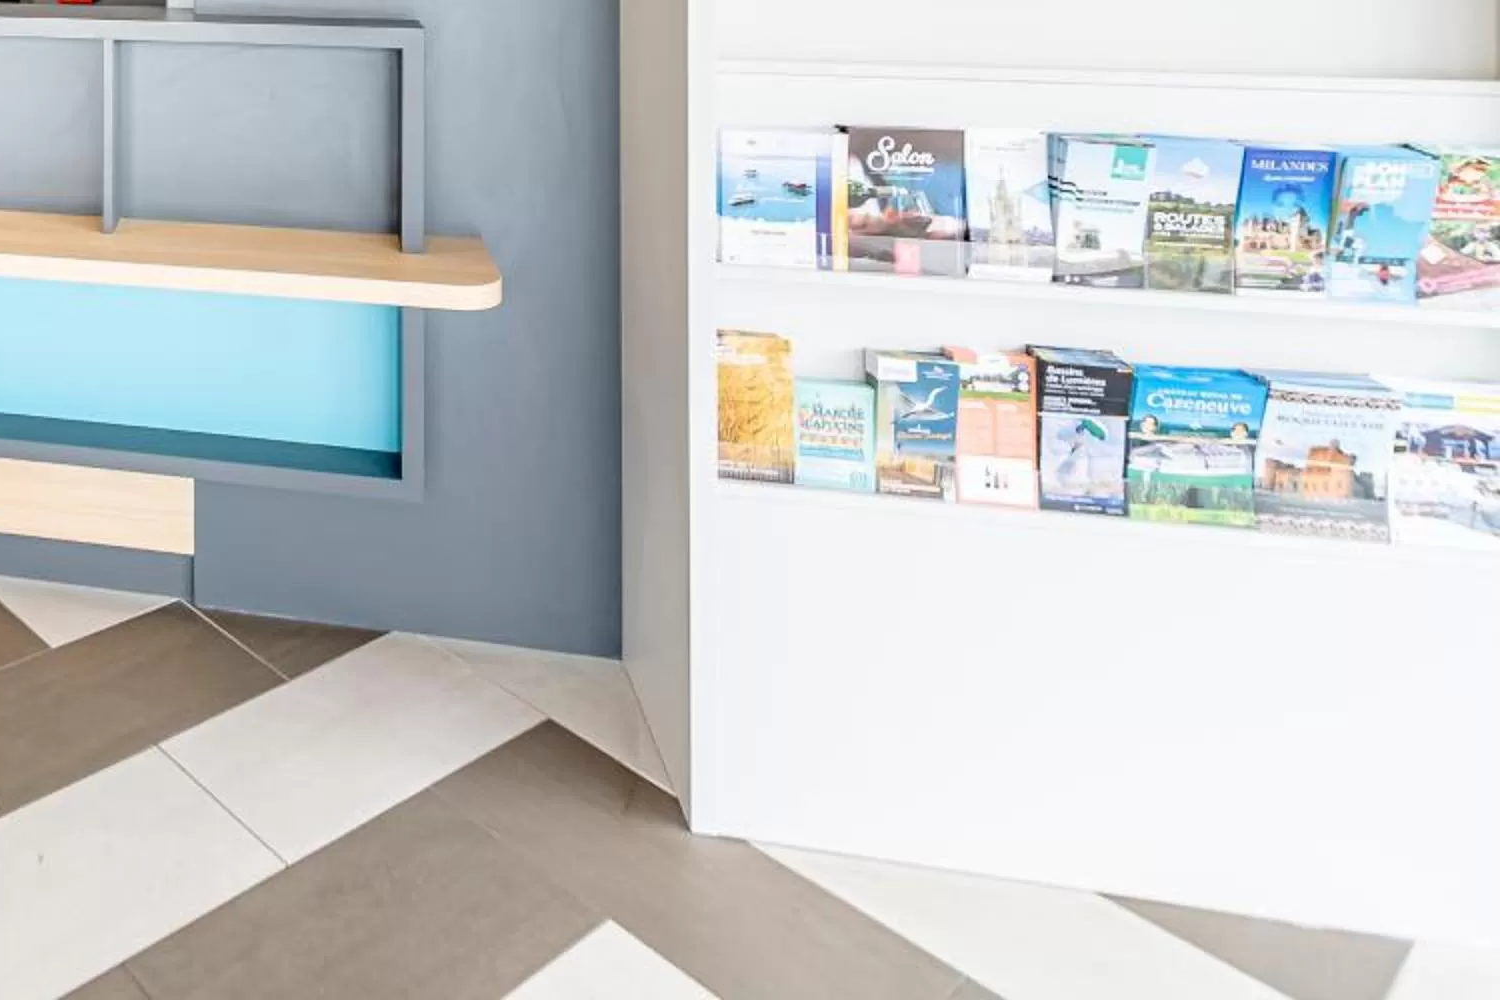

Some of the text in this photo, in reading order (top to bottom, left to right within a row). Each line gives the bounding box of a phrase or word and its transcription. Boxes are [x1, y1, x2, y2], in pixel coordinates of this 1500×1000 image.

[866, 135, 936, 172] Salon
[1251, 159, 1329, 173] MILANDES
[1146, 391, 1252, 416] Cazeneuve
